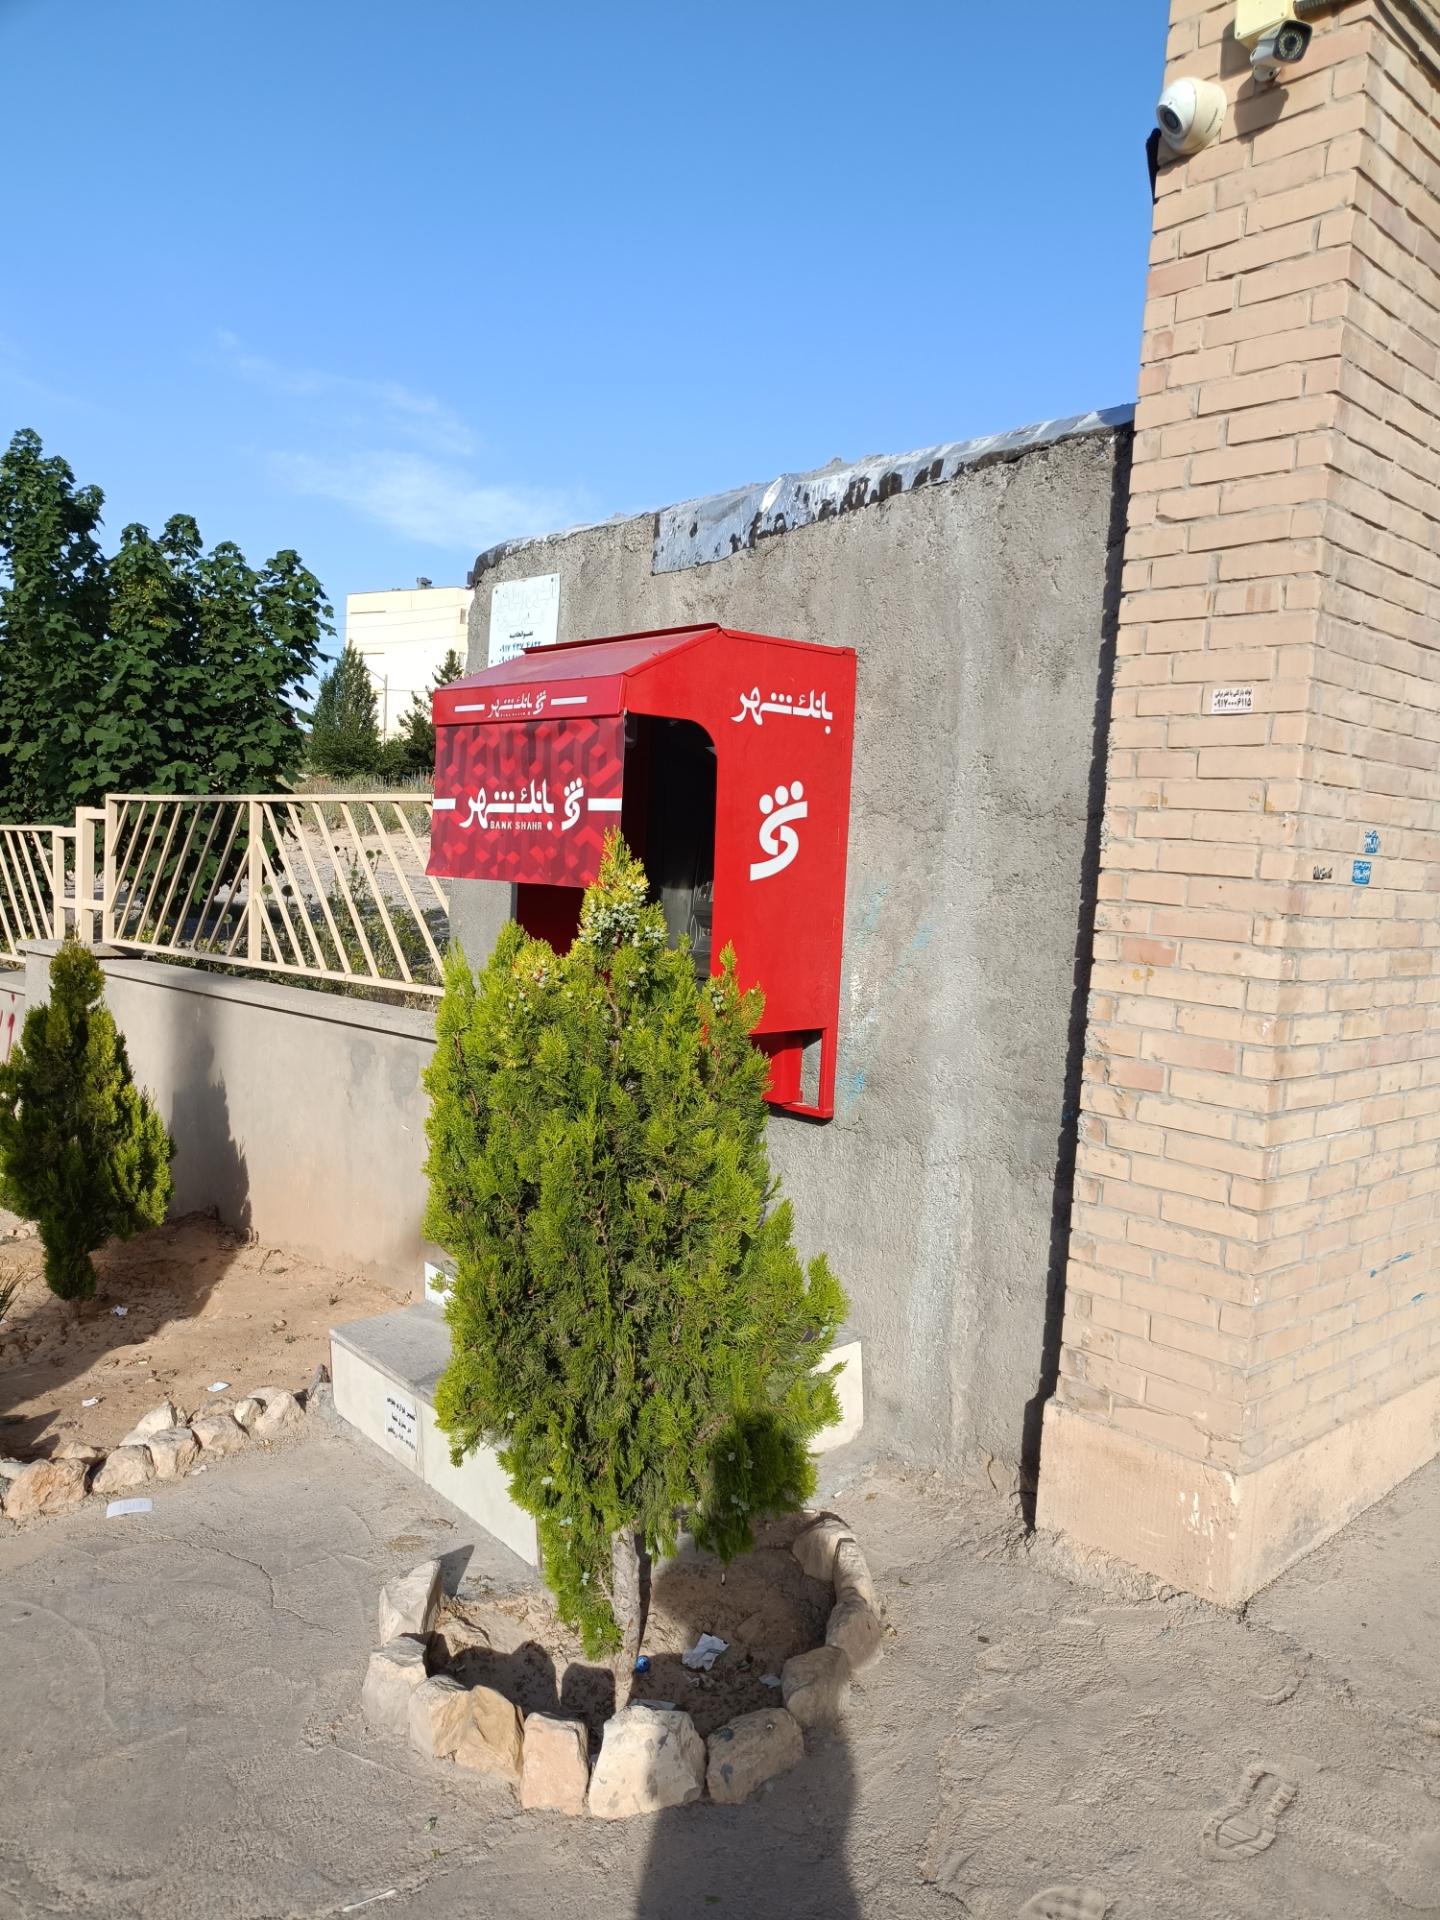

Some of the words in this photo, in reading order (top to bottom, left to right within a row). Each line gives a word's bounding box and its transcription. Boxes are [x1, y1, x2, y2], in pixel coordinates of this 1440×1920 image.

[487, 698, 513, 718] شهر
[730, 686, 792, 726] شهر
[459, 787, 515, 829] شهر
[490, 822, 512, 830] BANK
[515, 821, 543, 830] SHAHR
